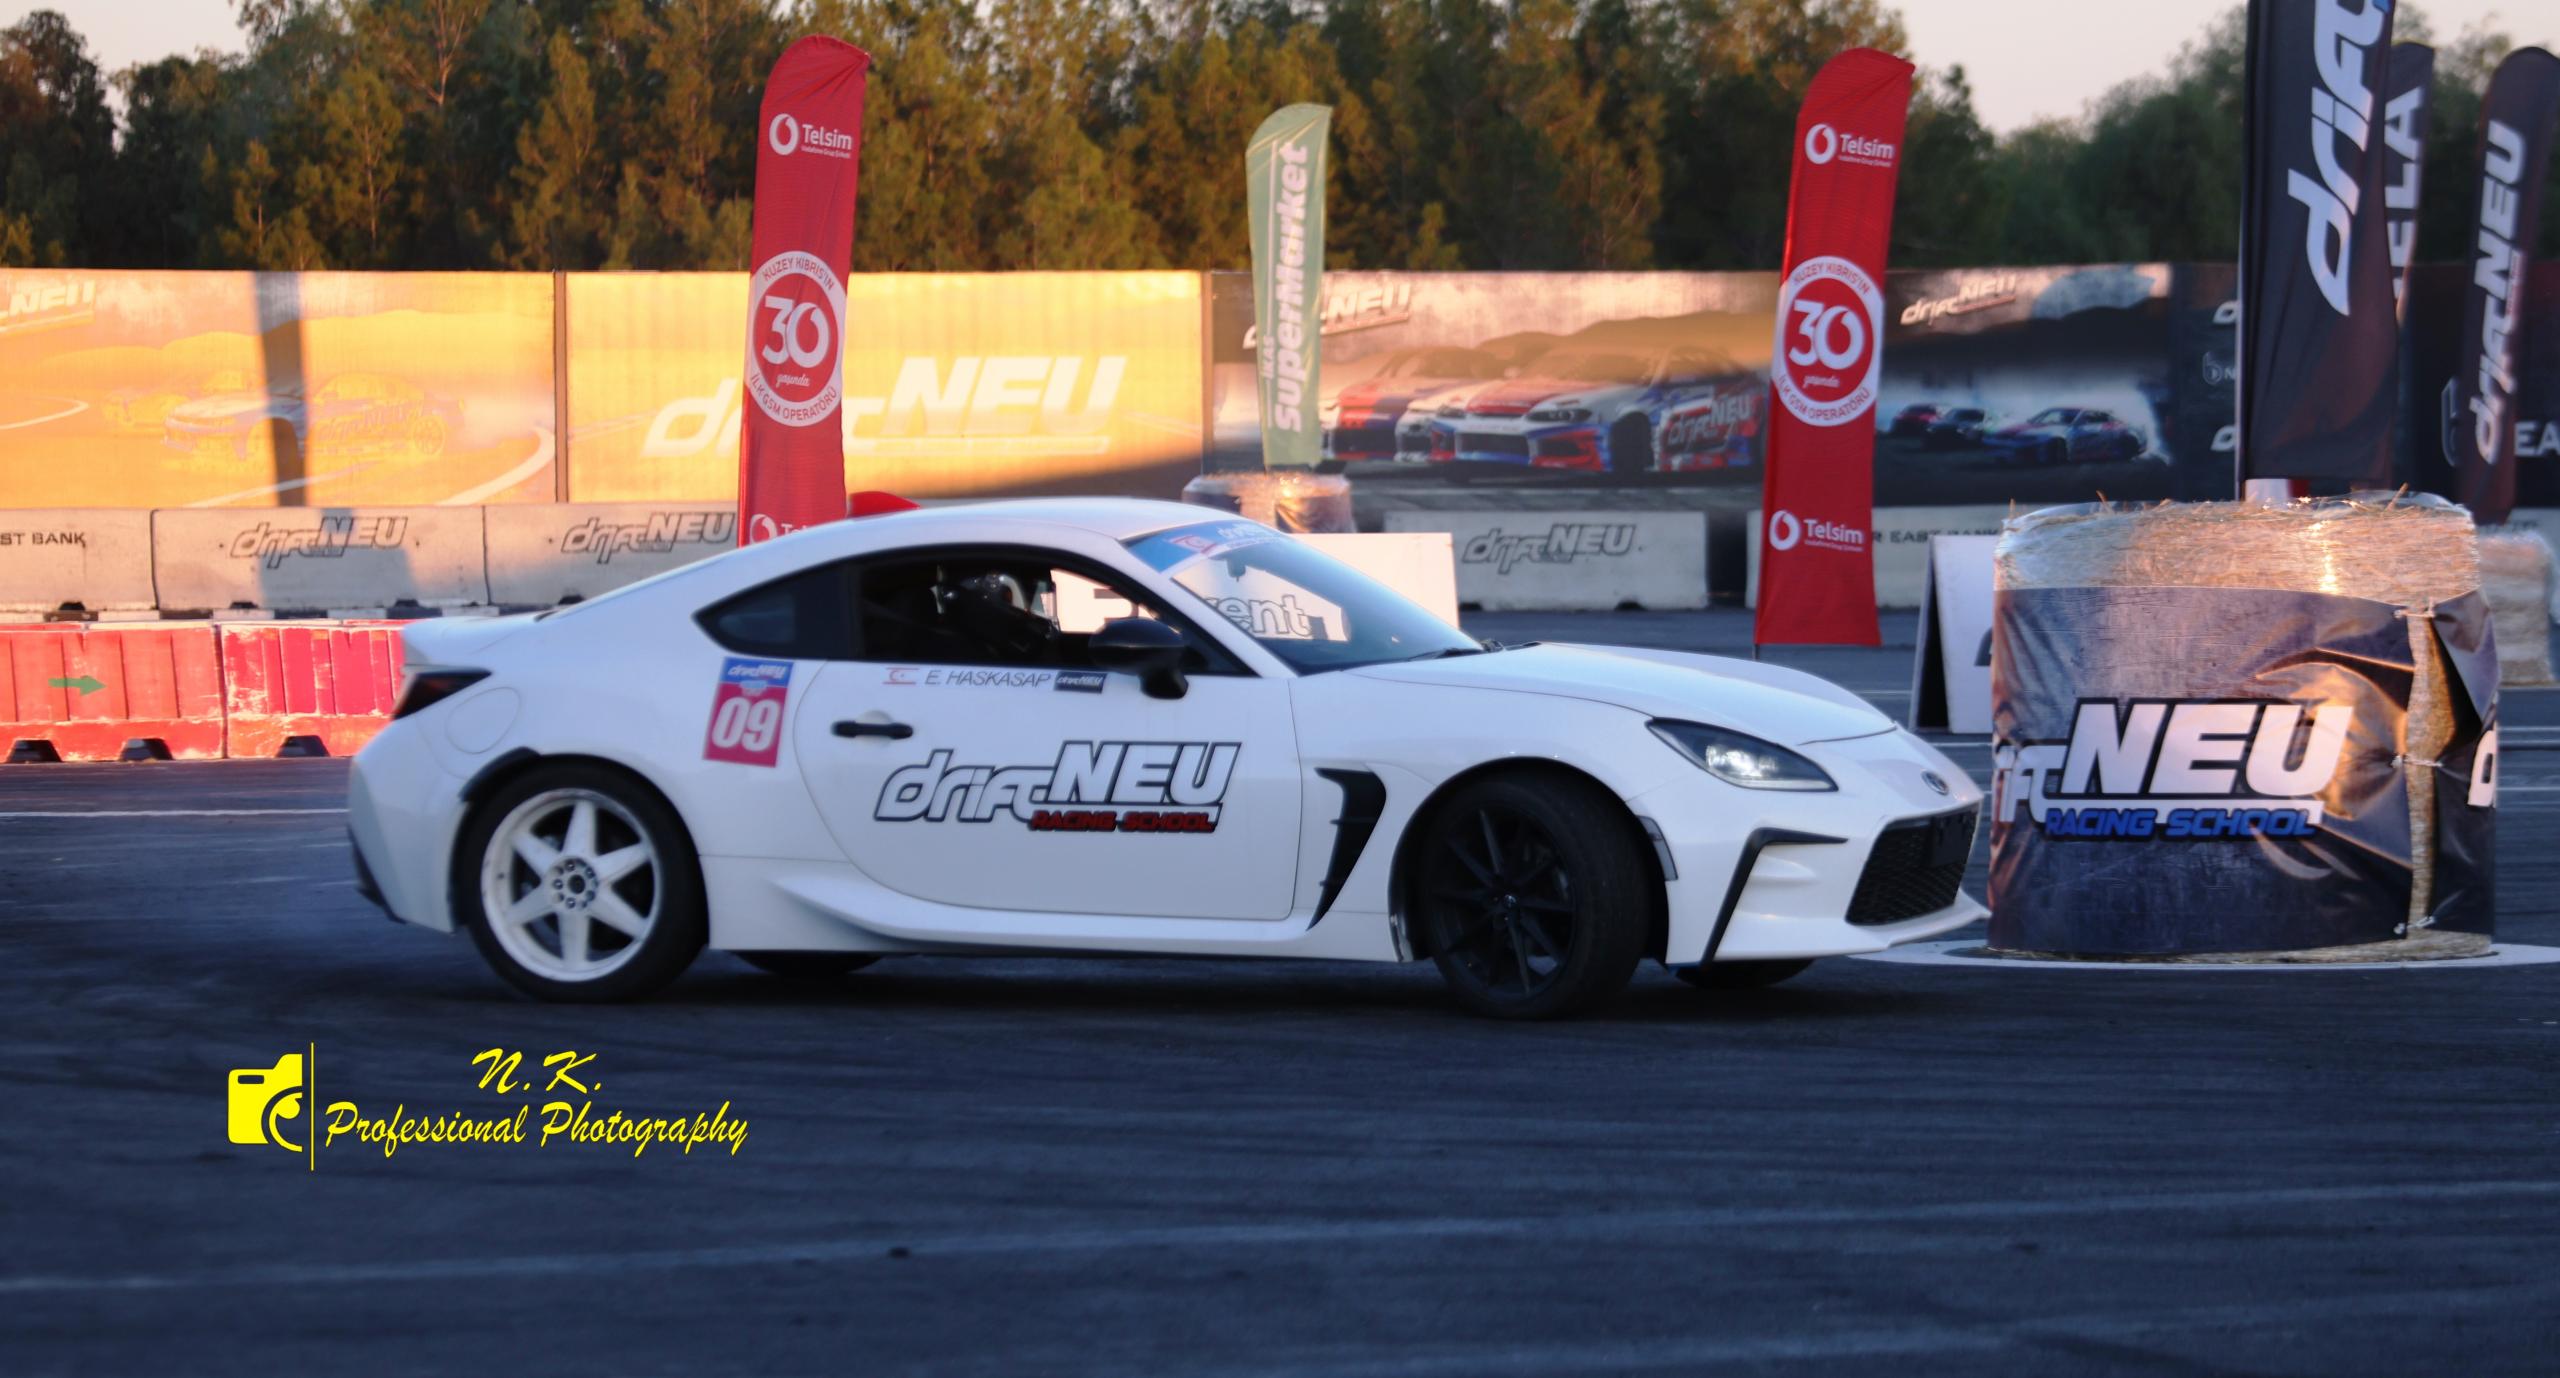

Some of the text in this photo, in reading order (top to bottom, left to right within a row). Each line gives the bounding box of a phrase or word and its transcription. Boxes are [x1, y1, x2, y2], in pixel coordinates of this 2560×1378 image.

[802, 123, 852, 150] Telsim
[1840, 134, 1894, 159] Telsim
[763, 257, 793, 282] KUZEY
[762, 295, 829, 368] 30
[1789, 299, 1864, 370] 30
[762, 393, 782, 417] GSM
[32, 532, 86, 548] BANK
[1804, 518, 1863, 545] Telsim
[924, 669, 1051, 688] E. HASKASAP
[711, 696, 780, 752] 09
[1028, 810, 1217, 833] RACING SCHOOL
[2044, 807, 2318, 838] RACING SCHOOL
